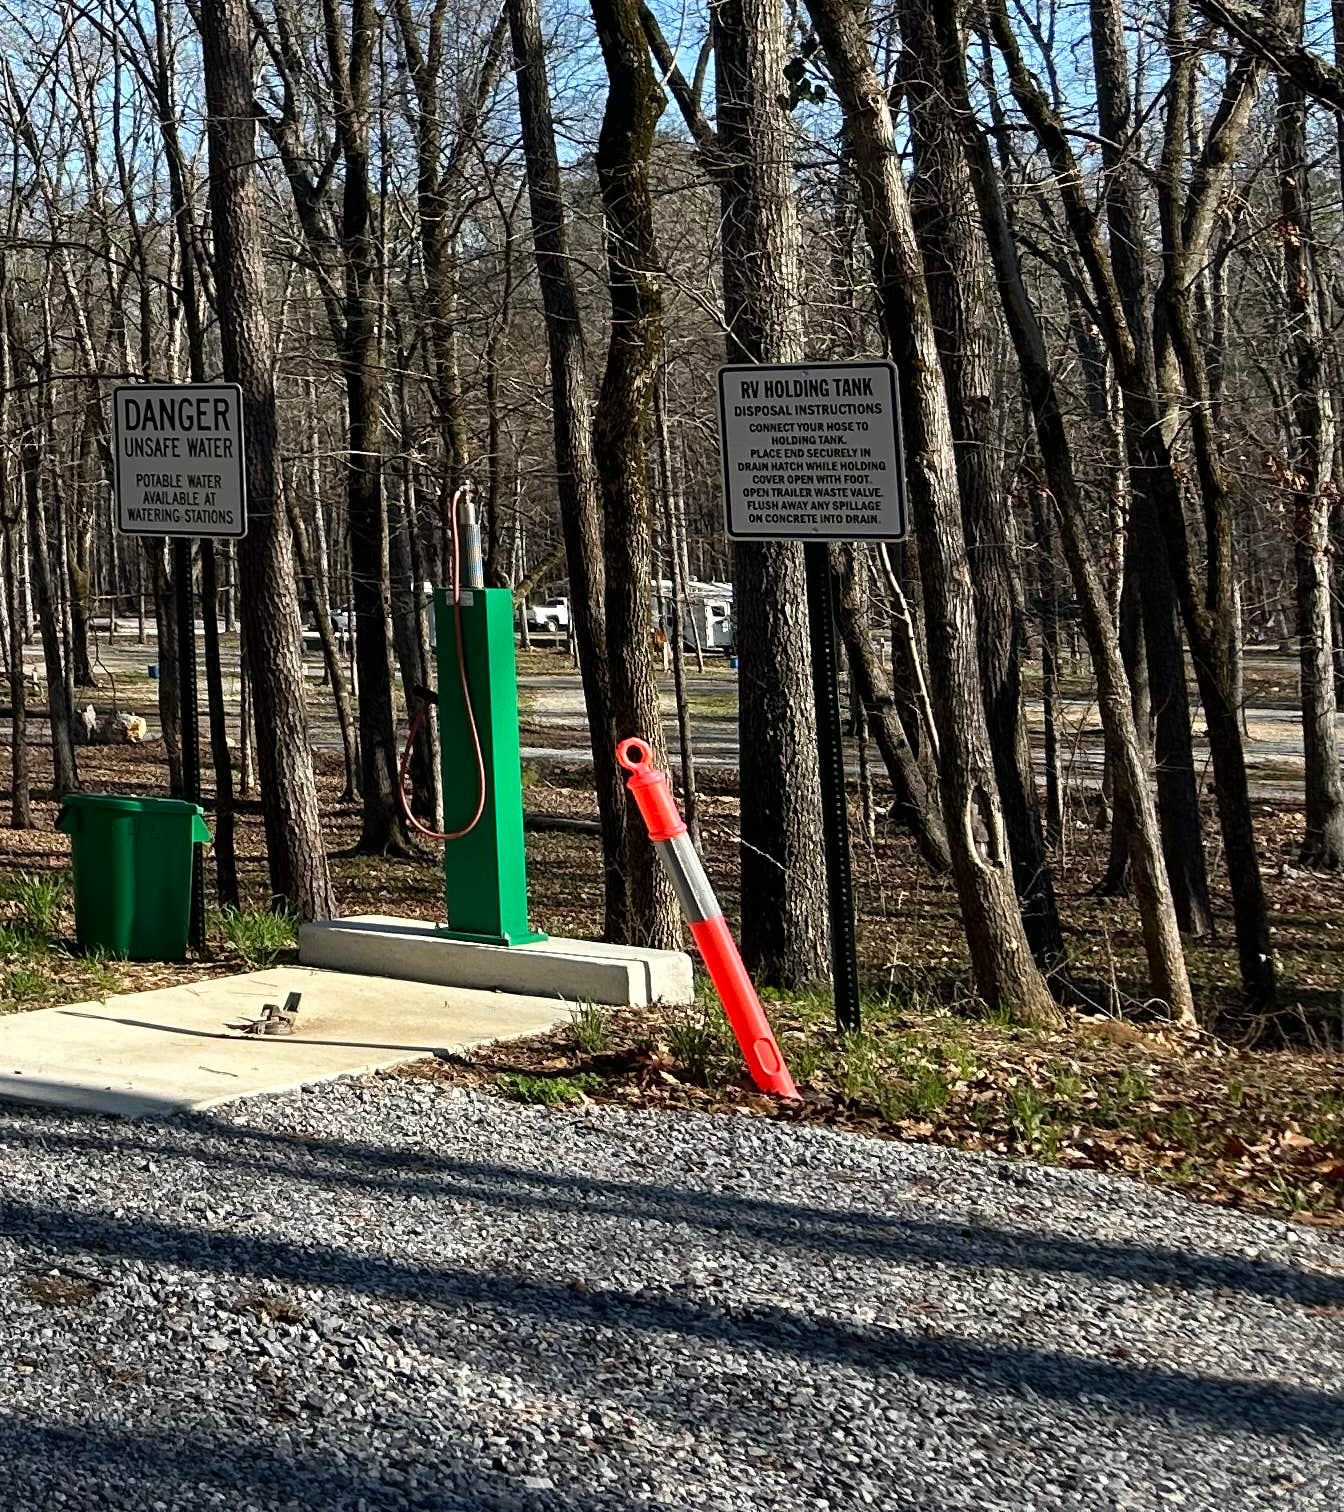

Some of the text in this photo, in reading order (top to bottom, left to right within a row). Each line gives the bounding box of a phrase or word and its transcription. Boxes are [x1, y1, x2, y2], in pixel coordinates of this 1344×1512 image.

[741, 378, 873, 399] RV HOLDING TANK
[125, 398, 230, 431] DANGER
[735, 403, 882, 417] DISPOSAL INSTRUCTIONS
[749, 422, 868, 432] CONNECT YOUR HOSE TO
[772, 436, 816, 445] HOLDING
[125, 437, 232, 458] UNSAFE WATER
[751, 448, 871, 458] PLACE END SECURELY IN
[738, 462, 886, 471] DRAIN HATCH WHILE HOLDING
[136, 474, 221, 488] POTABLE WATER
[752, 475, 784, 484] COVER
[787, 475, 812, 484] OPEN
[816, 475, 841, 484] WITH
[743, 488, 769, 497] OPEN
[771, 488, 812, 497] TRAILER
[815, 488, 848, 497] WASTE
[143, 491, 216, 505] AVAILABLE AT
[747, 501, 881, 510] FLUSH AWAY ANY SPILLAGE
[127, 508, 233, 524] WATERING STATIONS
[749, 514, 762, 523] ON
[765, 514, 817, 523] CONCRETE
[820, 514, 843, 523] INTO
